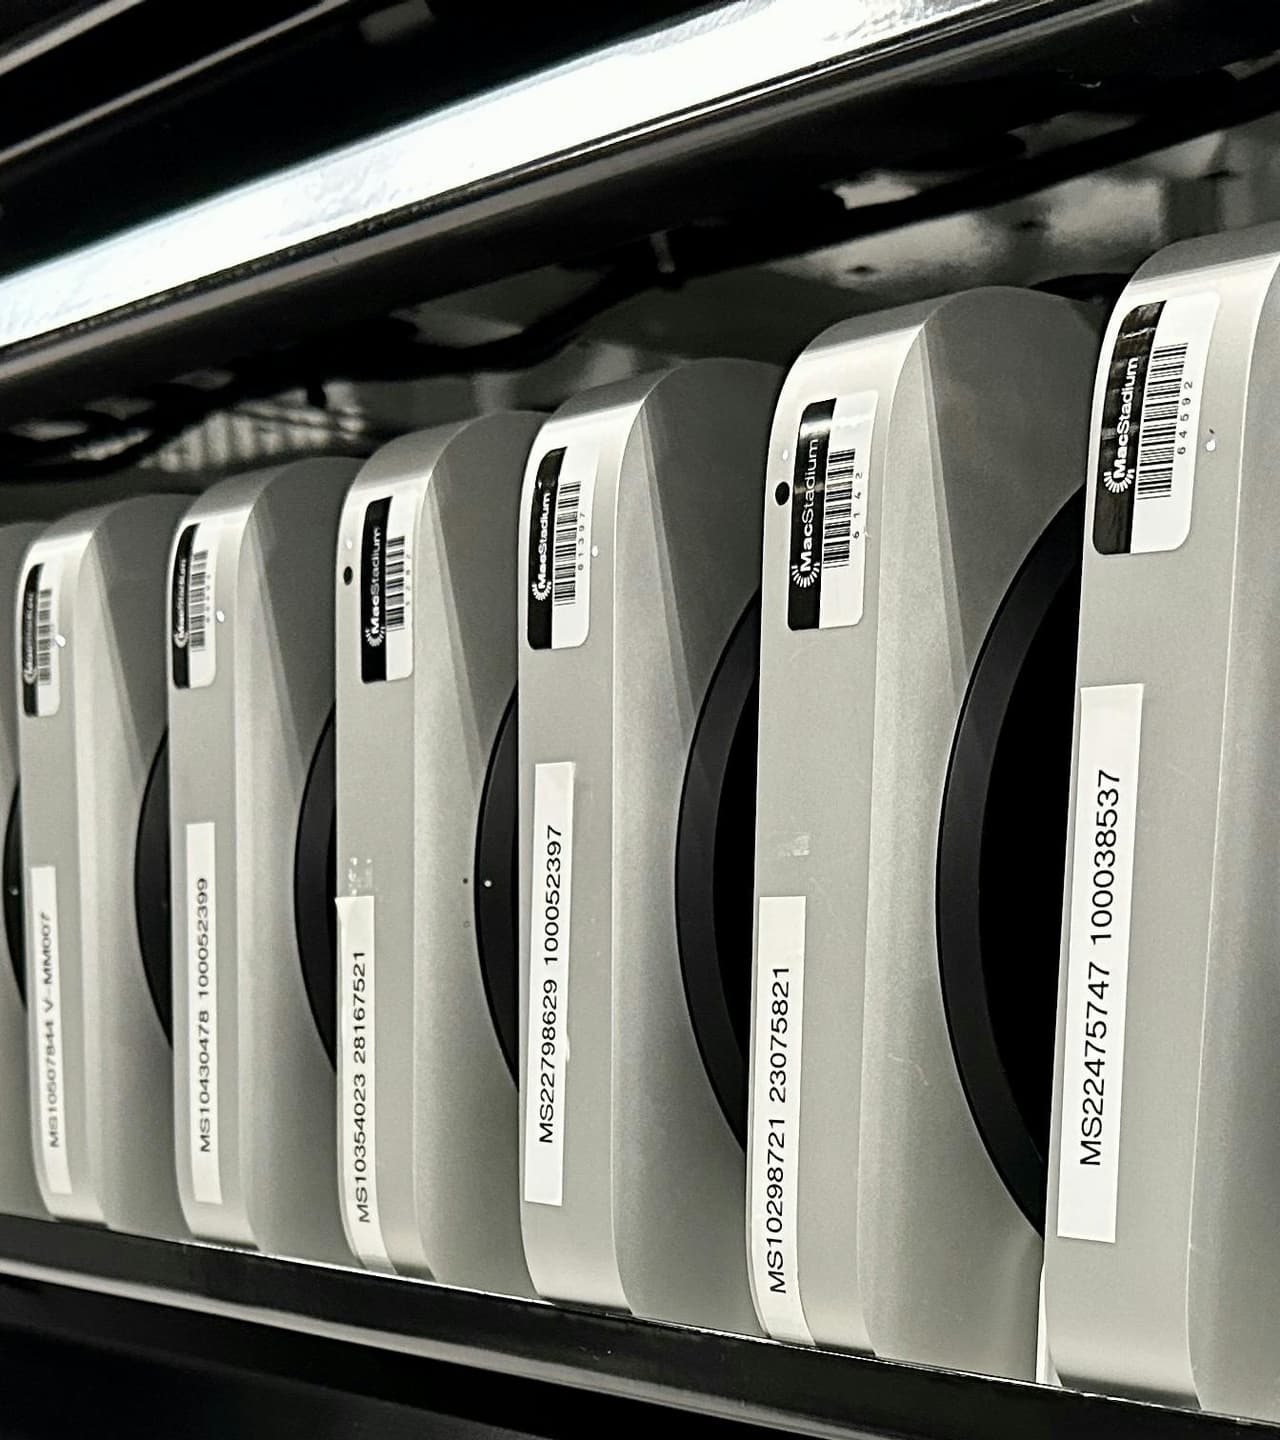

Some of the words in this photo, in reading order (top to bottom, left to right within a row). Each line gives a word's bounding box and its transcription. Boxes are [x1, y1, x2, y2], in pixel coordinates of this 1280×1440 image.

[1112, 356, 1140, 480] MacStadium
[538, 492, 551, 590] MacStadium
[800, 437, 819, 573] MacStadium
[371, 526, 382, 635] MacStadium
[544, 824, 562, 966] 100052397
[1090, 768, 1120, 945] 100038537
[196, 877, 209, 999] 100052399
[353, 950, 368, 1065] 28167521
[198, 1010, 211, 1153] MS10430478
[539, 979, 558, 1143] MS22798629
[769, 966, 790, 1103] 23075821
[1079, 961, 1111, 1167] MS22475747
[353, 1073, 371, 1224] MS10354023
[766, 1118, 787, 1295] MS10298721
